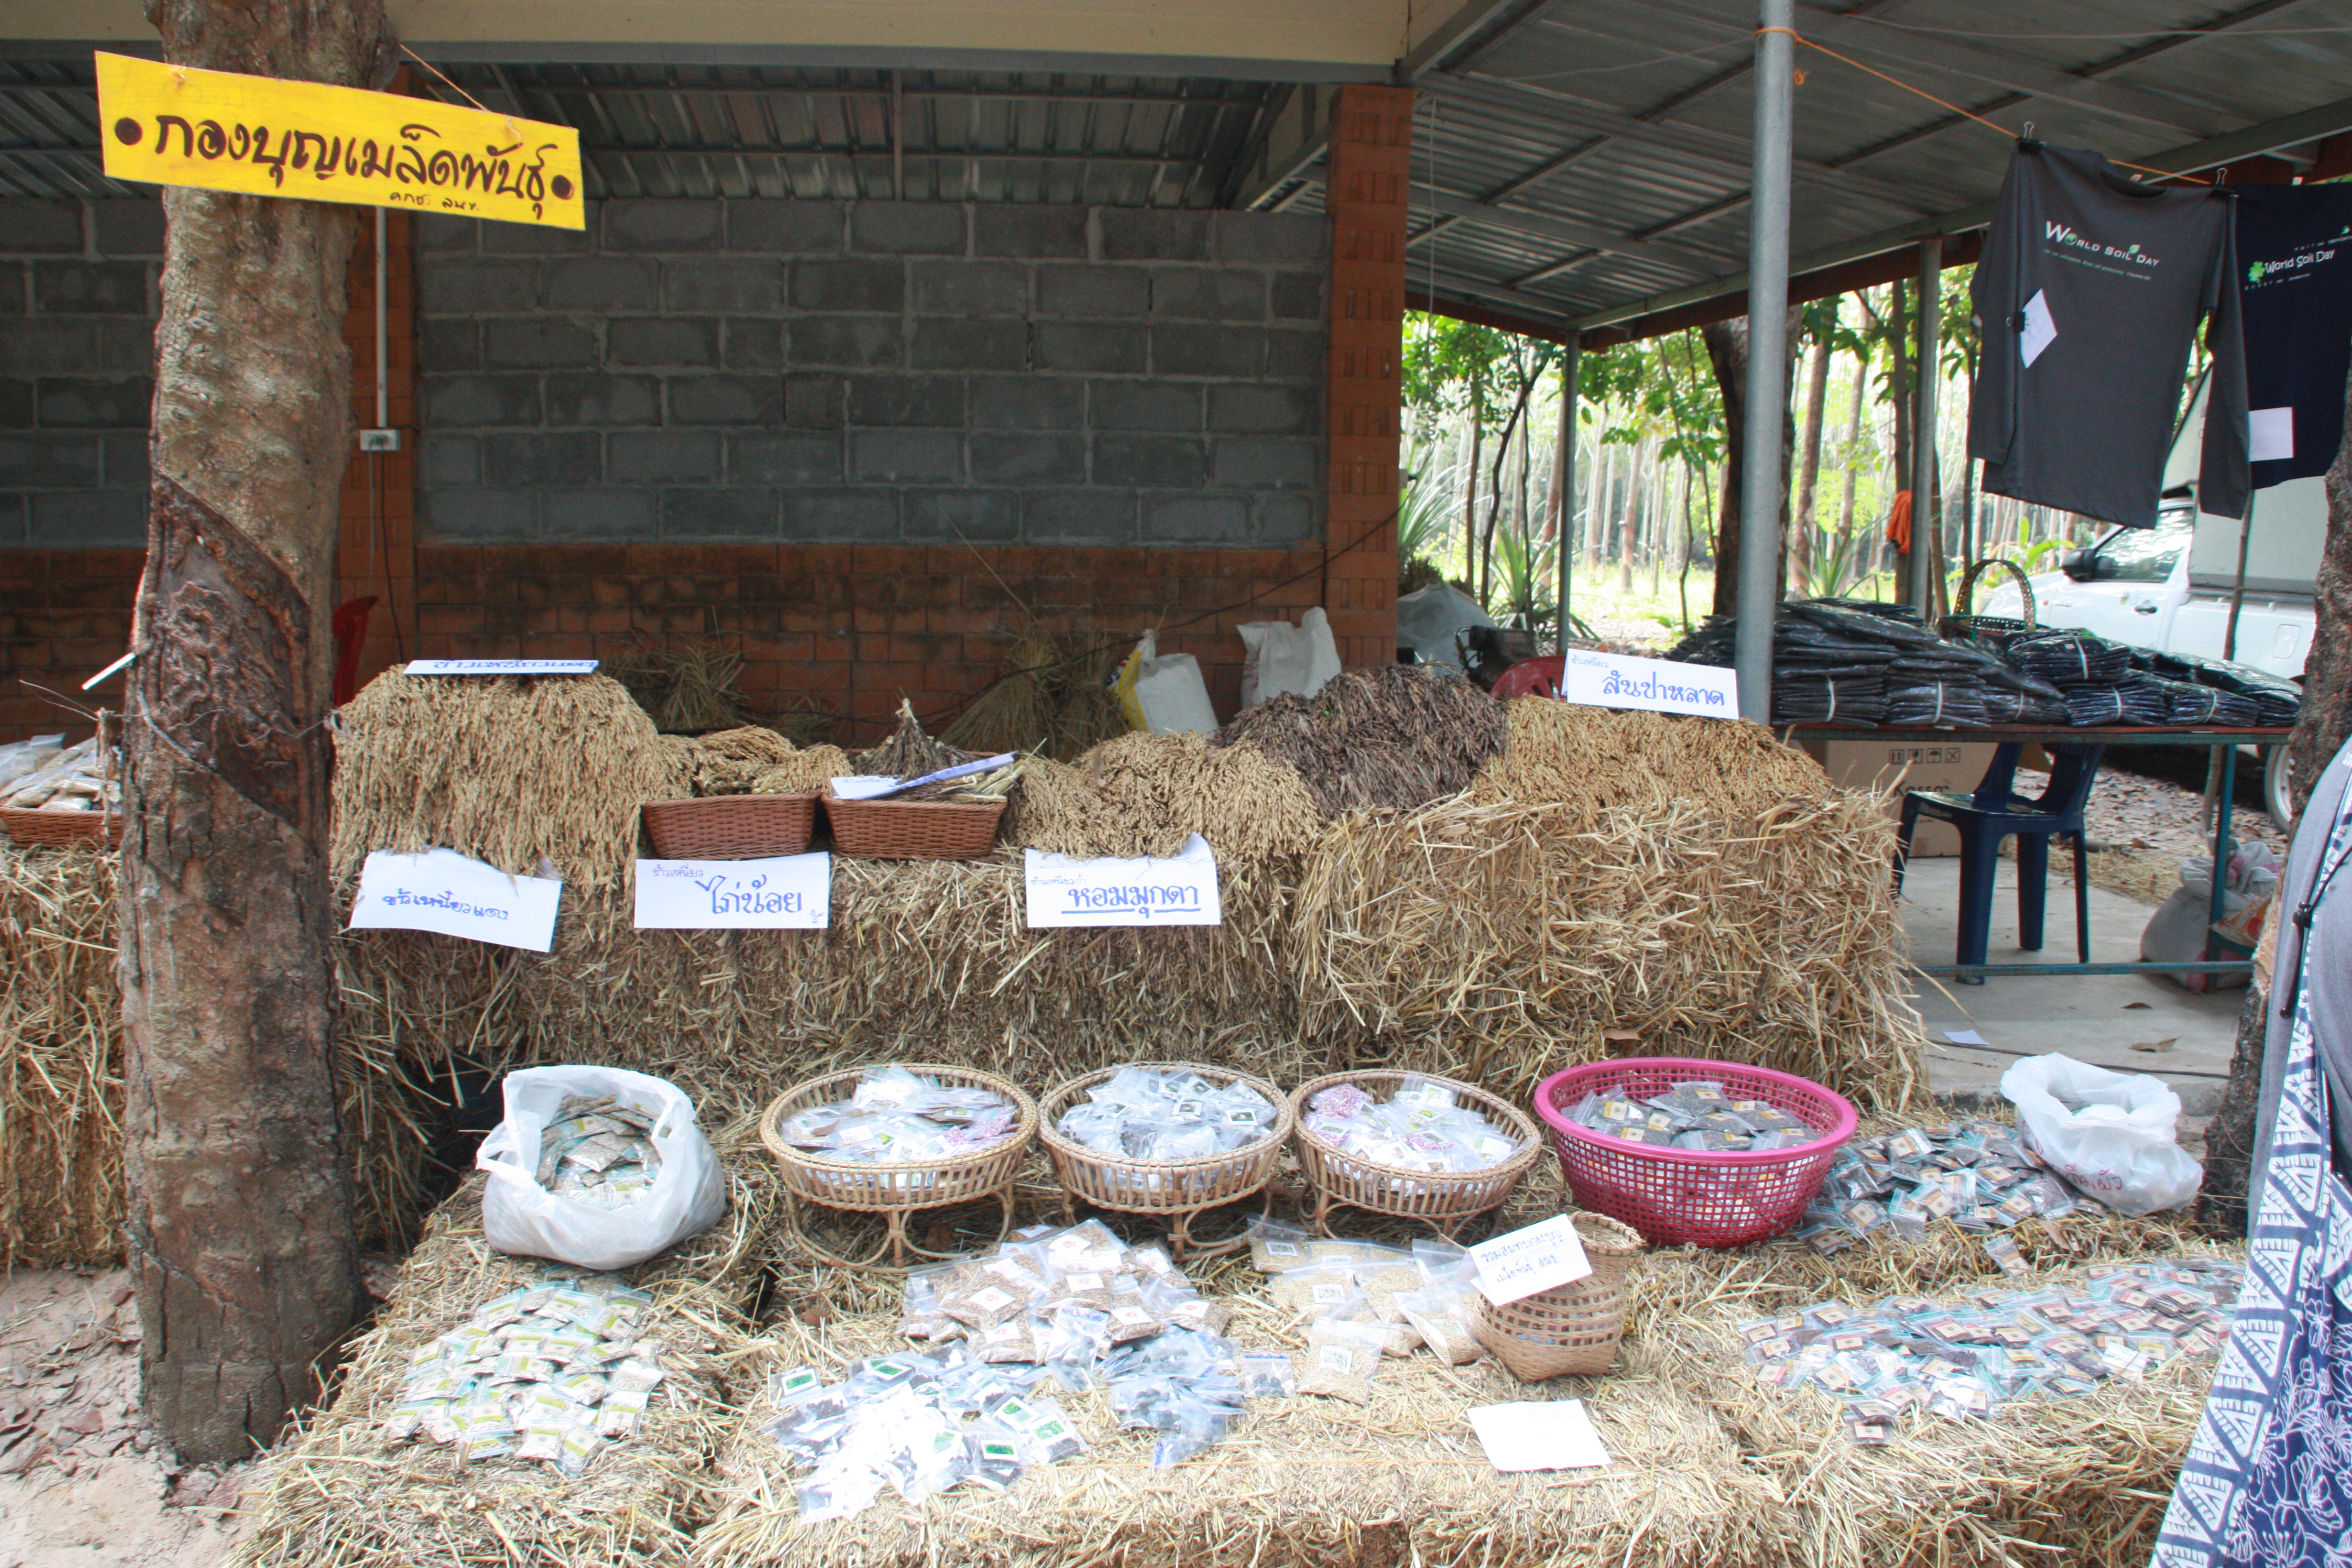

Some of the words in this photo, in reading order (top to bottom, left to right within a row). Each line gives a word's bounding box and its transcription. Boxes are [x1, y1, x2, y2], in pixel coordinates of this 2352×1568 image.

[2104, 246, 2132, 261] SOIL
[2136, 254, 2160, 266] DAY
[2264, 258, 2295, 274] World
[2296, 253, 2314, 269] Soil
[2315, 249, 2336, 263] Day
[694, 874, 802, 914] ไก่น้อย
[1068, 885, 1199, 919] หอมมุกดา
